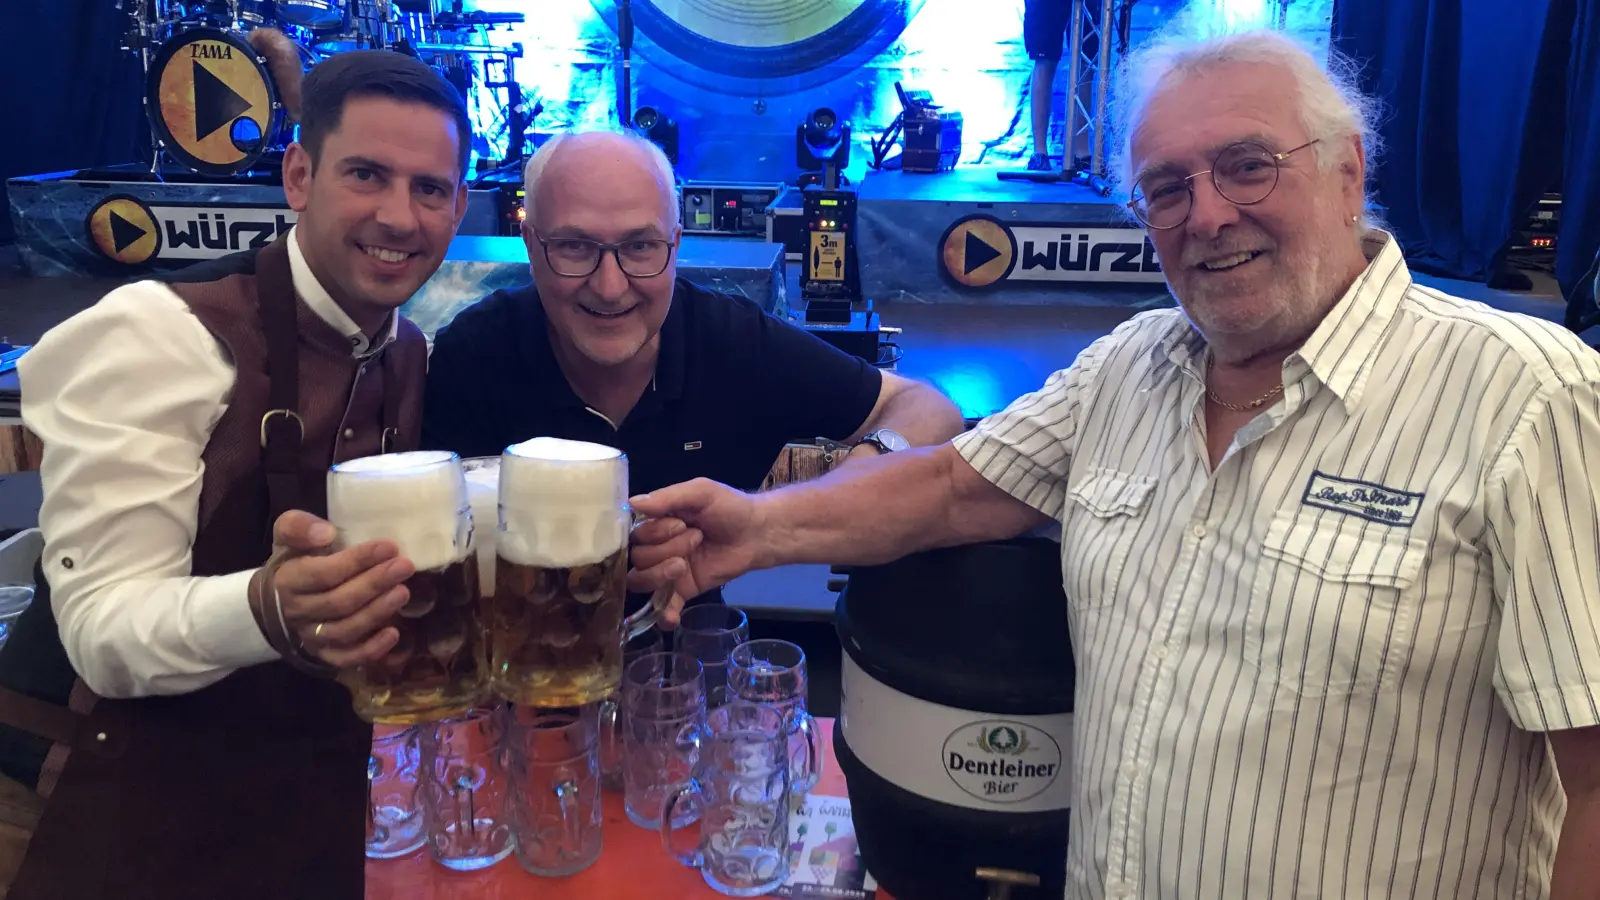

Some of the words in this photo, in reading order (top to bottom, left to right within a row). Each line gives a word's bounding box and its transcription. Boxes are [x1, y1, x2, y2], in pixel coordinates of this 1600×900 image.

[190, 44, 232, 59] TAMA
[820, 234, 838, 248] 3m
[949, 751, 1056, 778] Dentleiner
[983, 780, 1019, 795] Bier
